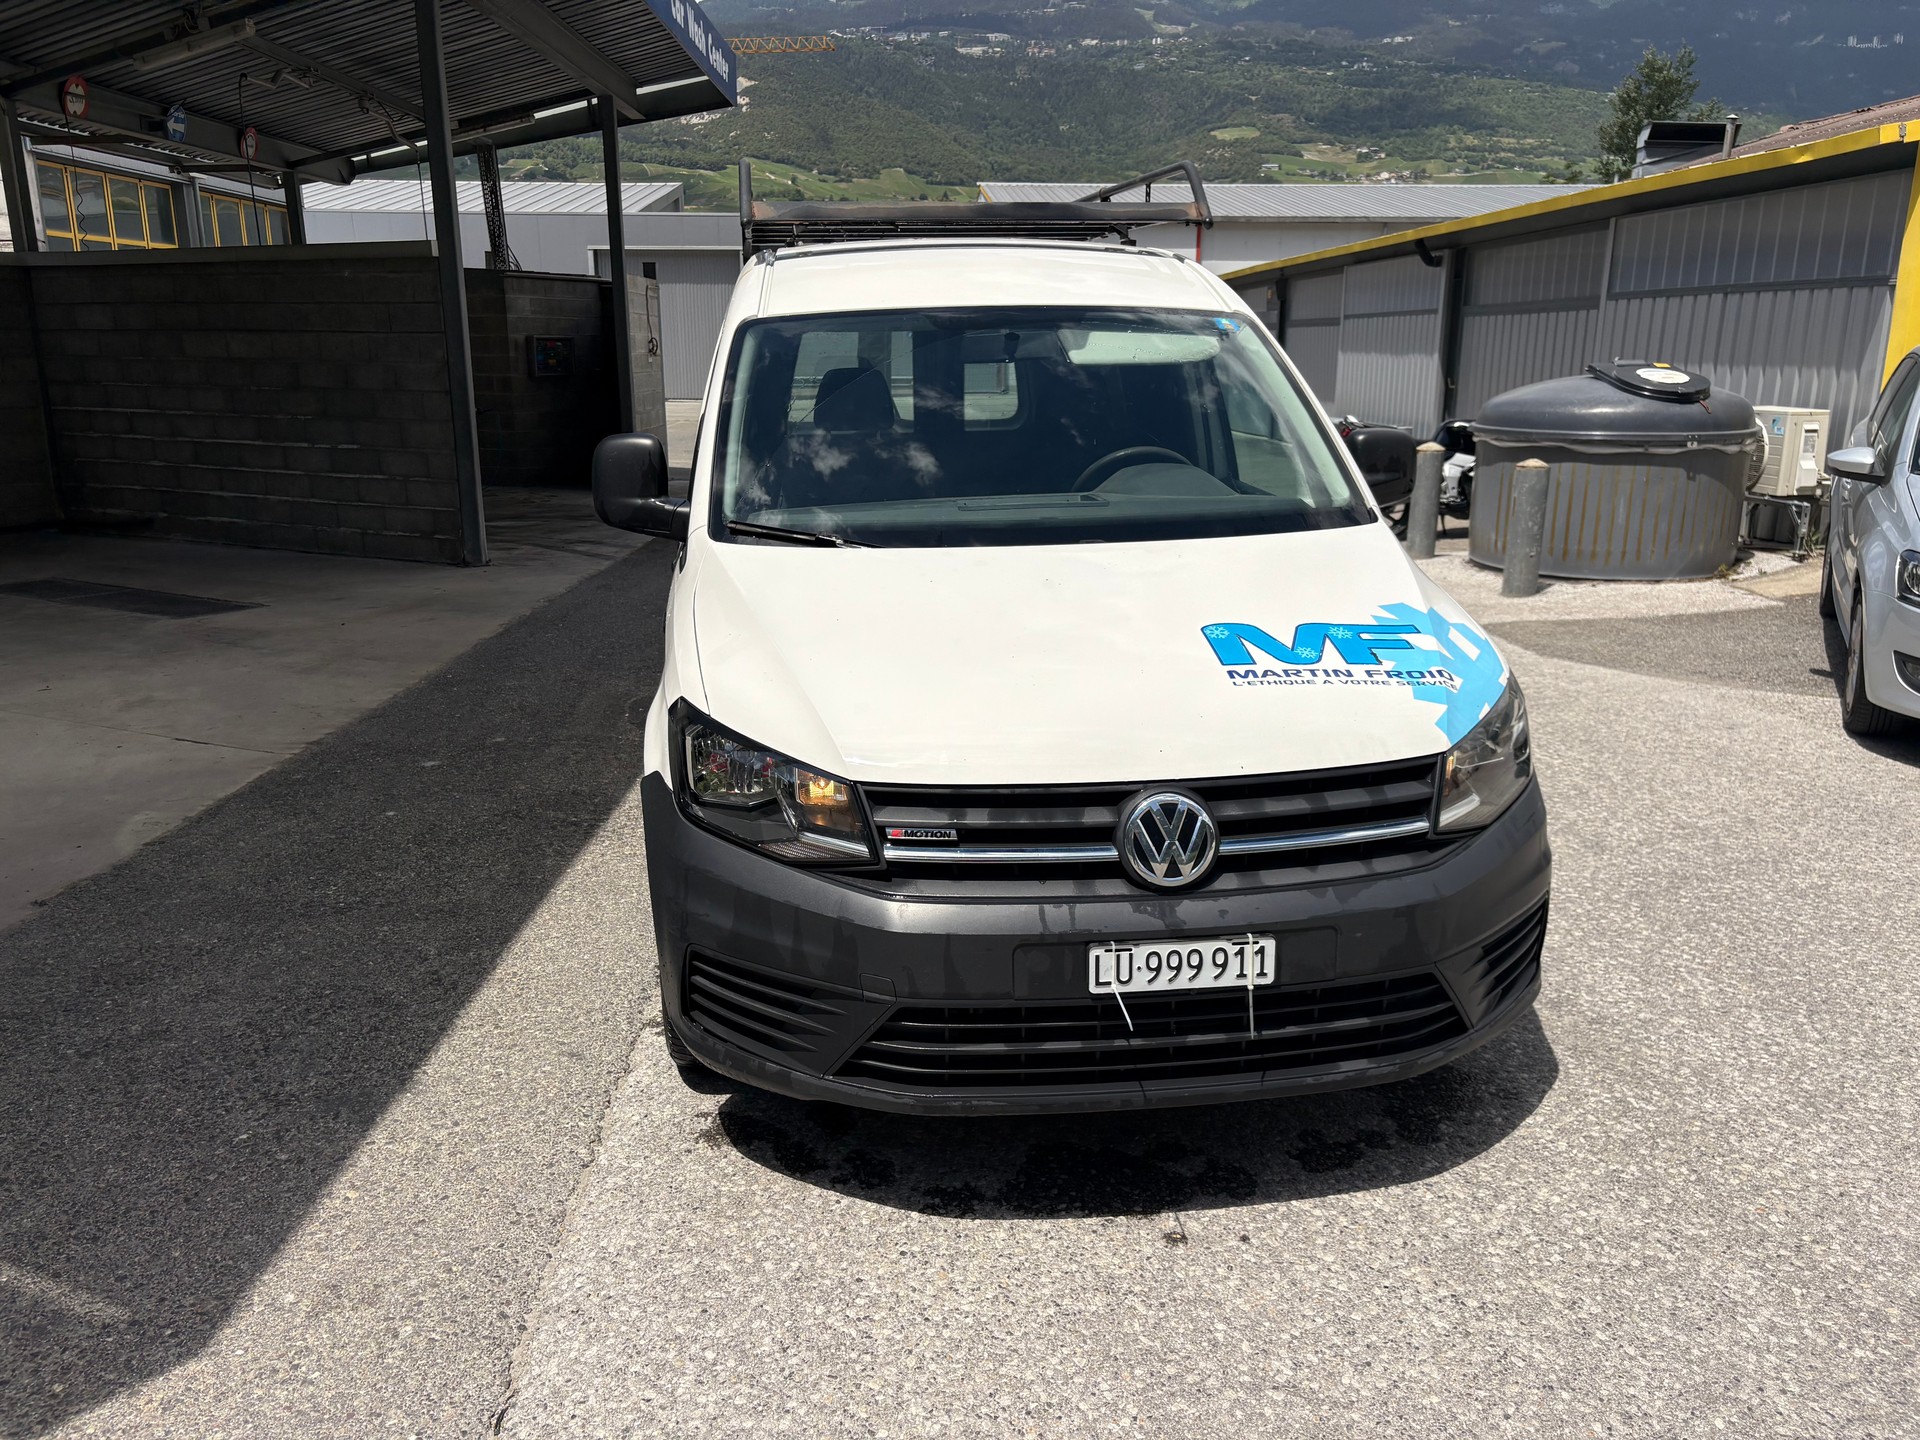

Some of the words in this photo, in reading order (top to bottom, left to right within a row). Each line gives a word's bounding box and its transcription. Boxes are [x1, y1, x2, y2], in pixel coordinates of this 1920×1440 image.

[671, 0, 684, 28] Car
[686, 2, 706, 56] Wash
[708, 33, 728, 82] Center
[1200, 622, 1421, 666] MF
[1226, 669, 1354, 679] MARTIN
[1363, 669, 1455, 682] FROID
